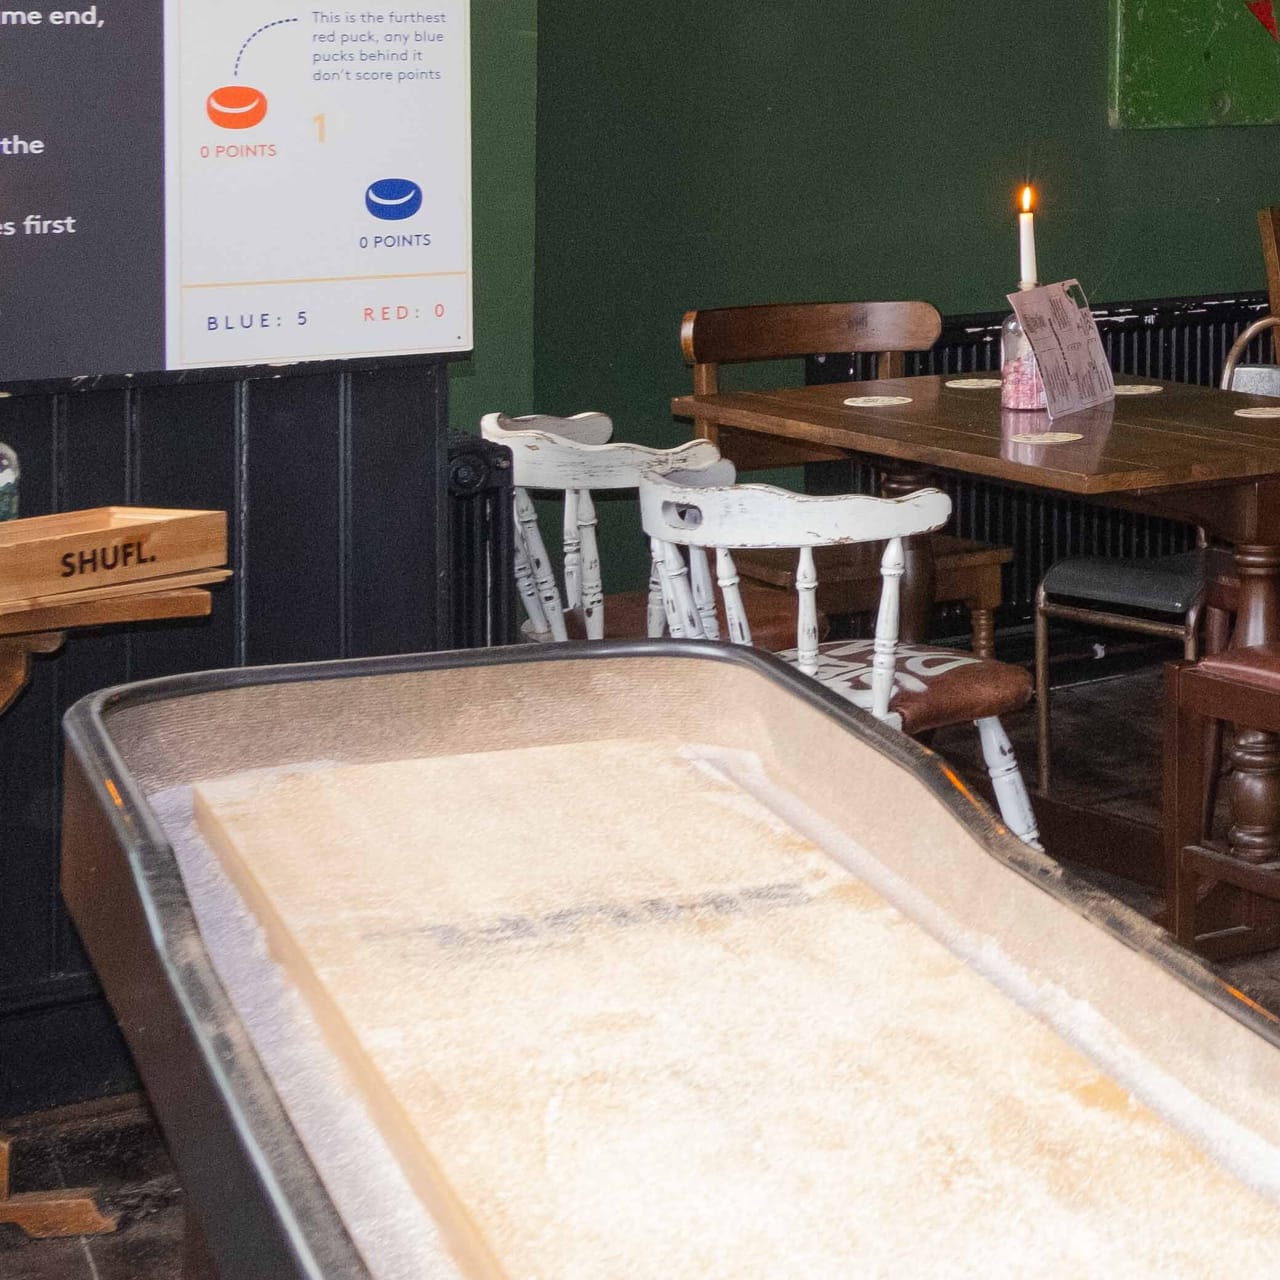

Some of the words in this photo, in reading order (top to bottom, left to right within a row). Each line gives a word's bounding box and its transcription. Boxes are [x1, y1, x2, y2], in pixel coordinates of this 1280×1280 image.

[49, 5, 105, 28] end,
[312, 11, 341, 23] This
[345, 11, 356, 23] is
[360, 11, 384, 23] the
[389, 10, 447, 23] furthest
[312, 30, 335, 42] red
[340, 30, 380, 46] puck,
[384, 32, 411, 46] any
[414, 29, 444, 42] blue
[312, 49, 355, 65] pucks
[359, 48, 408, 61] behind
[413, 49, 424, 61] it
[312, 68, 351, 81] don't
[356, 70, 393, 80] score
[397, 68, 441, 83] points
[312, 112, 326, 143] 1
[0, 134, 45, 154] the
[200, 145, 210, 159] 0
[215, 144, 278, 158] POINTS
[22, 214, 77, 234] first
[359, 236, 368, 248] 0
[374, 233, 432, 248] POINTS
[207, 312, 282, 331] BLUE:
[297, 310, 308, 326] 5
[363, 304, 419, 322] RED:
[434, 303, 445, 318] 0
[61, 541, 157, 578] SHUFL.
